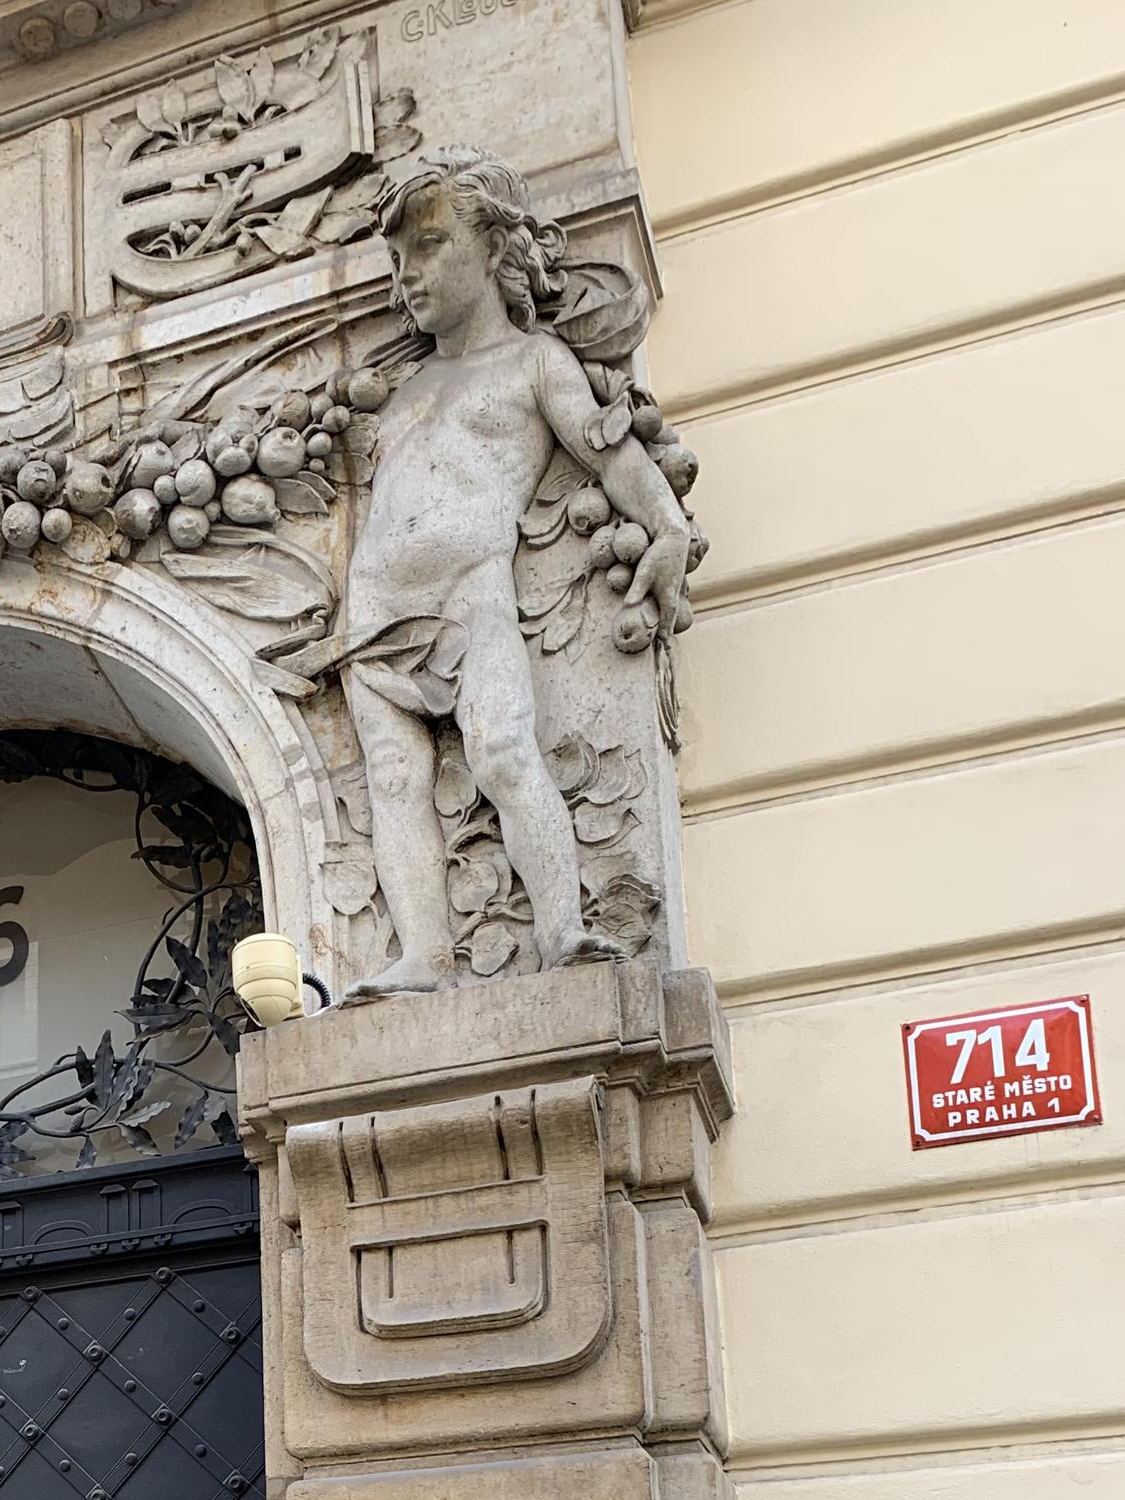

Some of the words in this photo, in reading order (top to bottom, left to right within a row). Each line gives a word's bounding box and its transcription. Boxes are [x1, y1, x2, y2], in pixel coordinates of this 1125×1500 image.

[945, 1018, 1051, 1085] 714
[931, 1080, 996, 1109] STARÉ
[1004, 1074, 1073, 1097] MĚSTO
[947, 1100, 1037, 1128] PRAHA
[1047, 1097, 1061, 1113] 1
